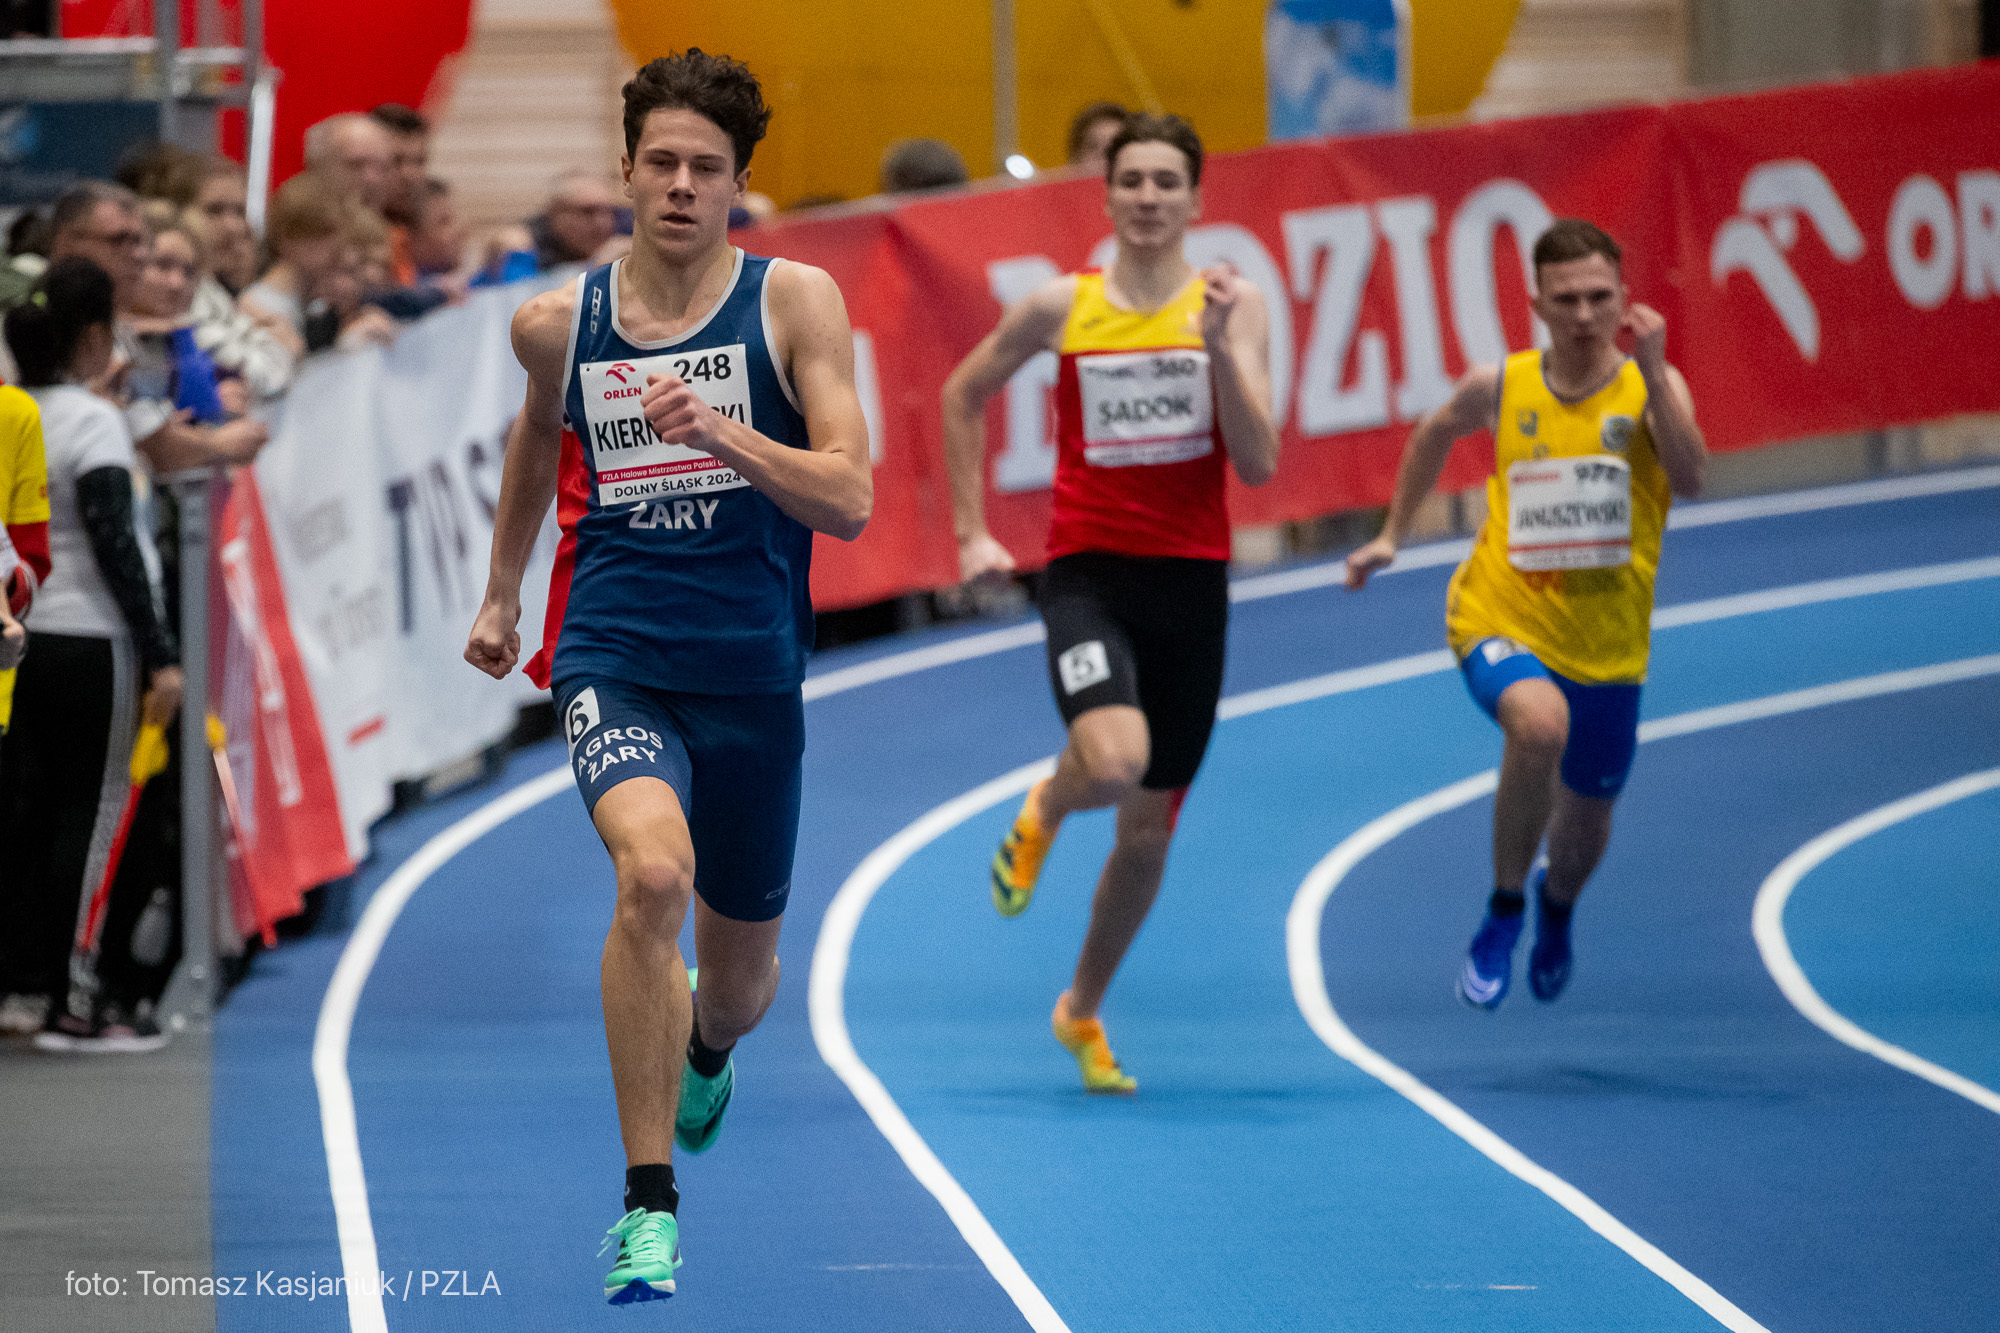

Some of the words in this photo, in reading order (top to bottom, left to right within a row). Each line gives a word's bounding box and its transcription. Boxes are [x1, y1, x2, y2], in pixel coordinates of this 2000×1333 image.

[673, 353, 732, 384] 248
[603, 386, 642, 400] ORLEN
[1099, 394, 1193, 425] SADOK
[602, 473, 619, 482] PZLA
[620, 469, 648, 479] Halowe
[648, 463, 692, 475] Mistrzostwa
[693, 459, 716, 470] Polski
[614, 482, 658, 498] DOLNY
[661, 476, 703, 492] ŚLĄSK
[706, 472, 742, 486] 2024
[569, 700, 590, 744] 6
[578, 726, 663, 777] AGROS
[587, 745, 657, 784] ŻARY
